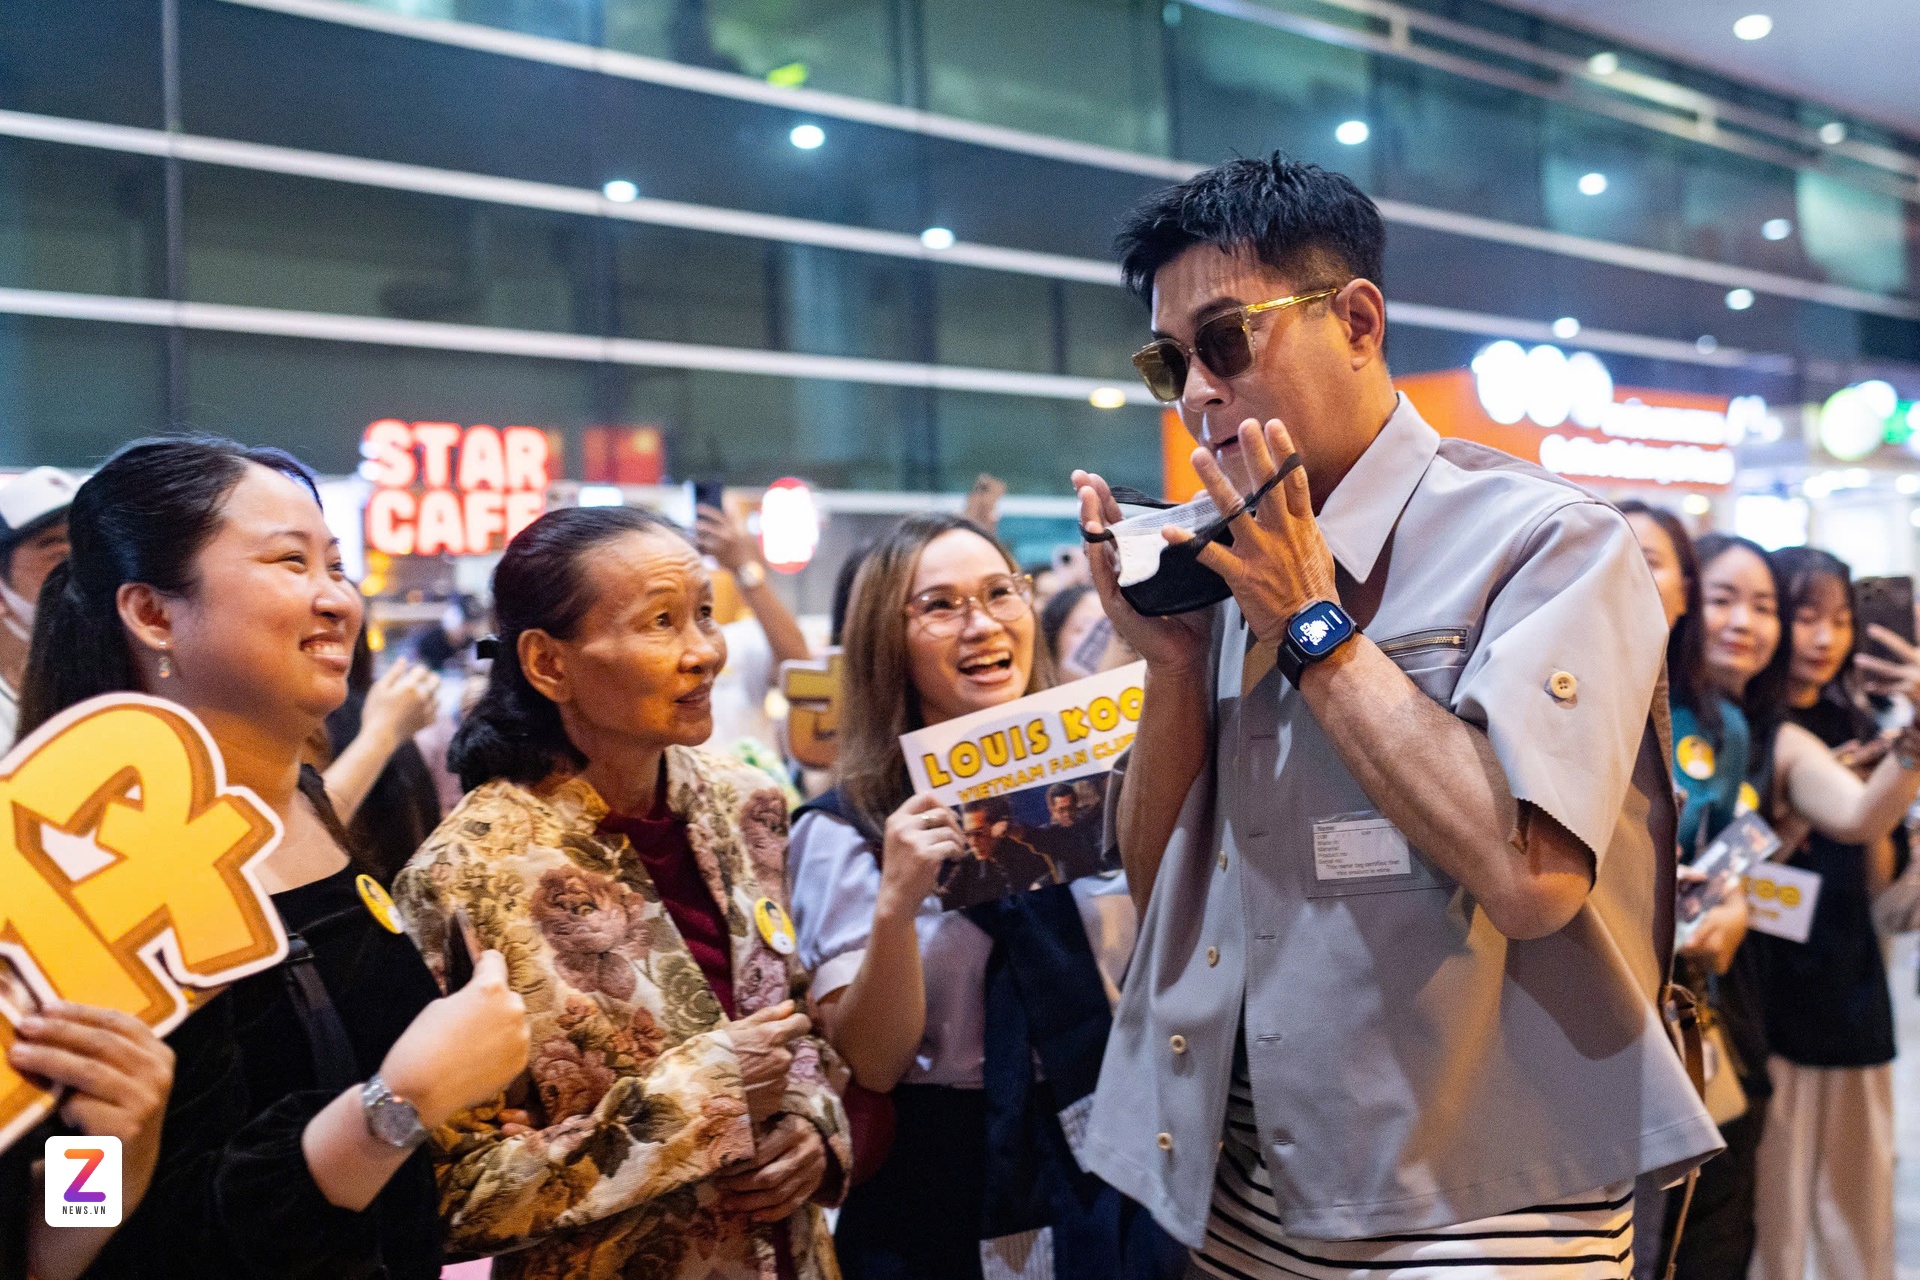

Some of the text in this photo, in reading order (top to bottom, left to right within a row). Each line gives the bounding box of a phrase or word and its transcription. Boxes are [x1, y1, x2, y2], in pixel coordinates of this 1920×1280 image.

[363, 418, 550, 491] STAR
[923, 687, 1144, 788] LOUIS KOO
[957, 763, 1046, 802] VIETNAM
[1049, 749, 1089, 774] FAN
